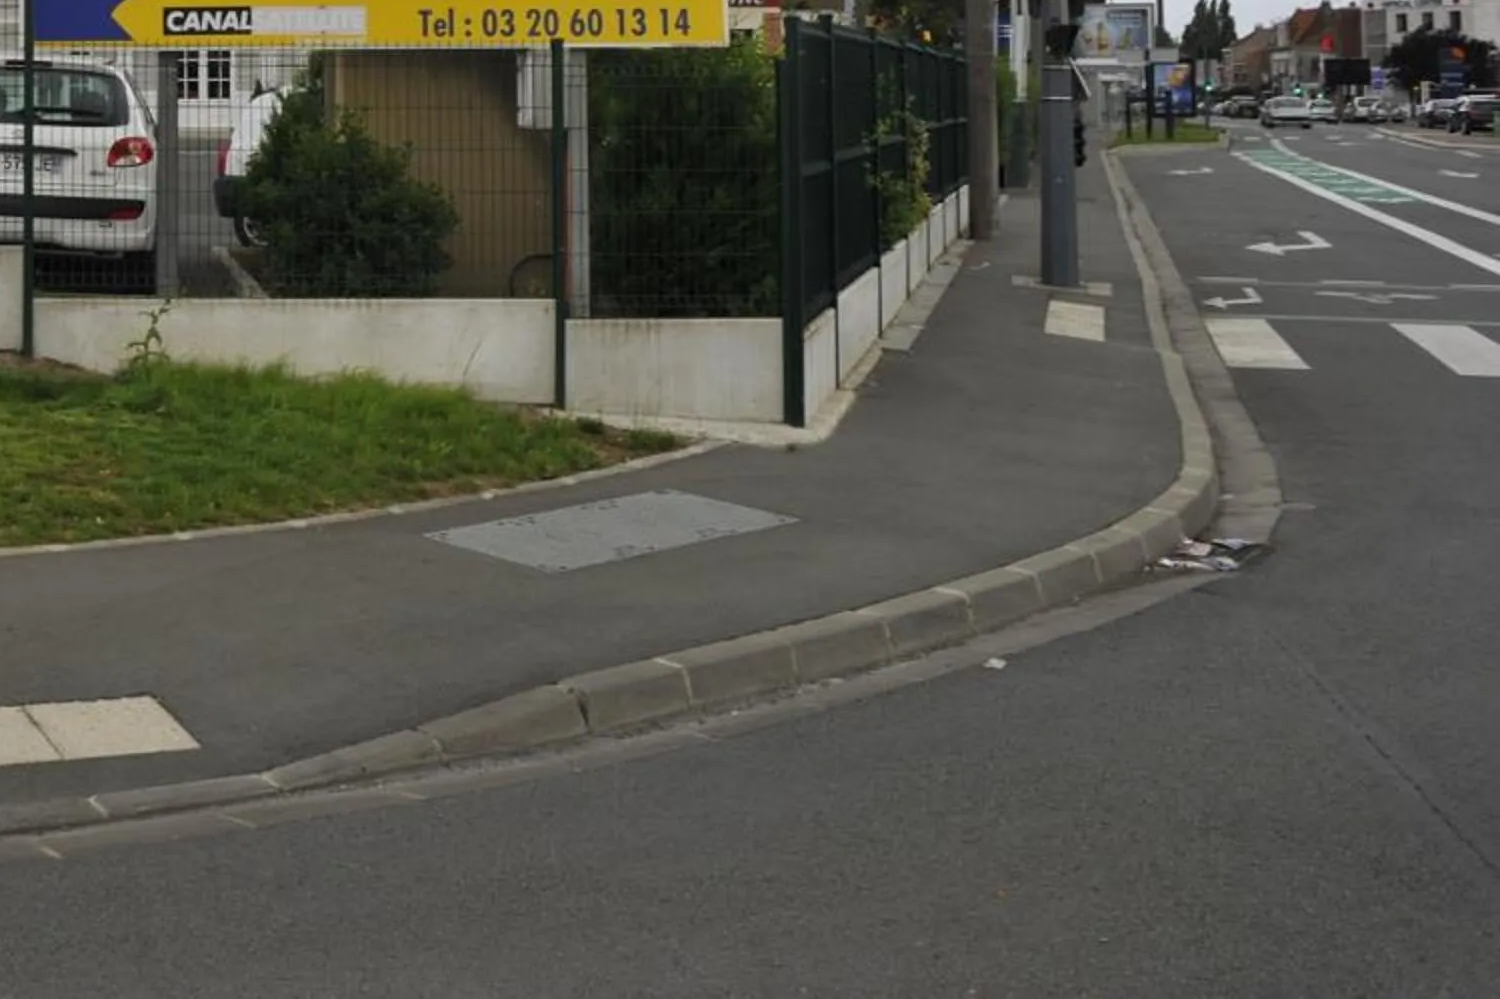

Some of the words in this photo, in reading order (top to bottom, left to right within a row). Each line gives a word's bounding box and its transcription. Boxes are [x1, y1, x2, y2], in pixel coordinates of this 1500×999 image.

[166, 10, 252, 31] CANAL
[482, 9, 515, 37] 03
[525, 9, 559, 37] 20
[569, 9, 602, 37] 60
[616, 9, 647, 37] 13
[659, 9, 691, 37] 14
